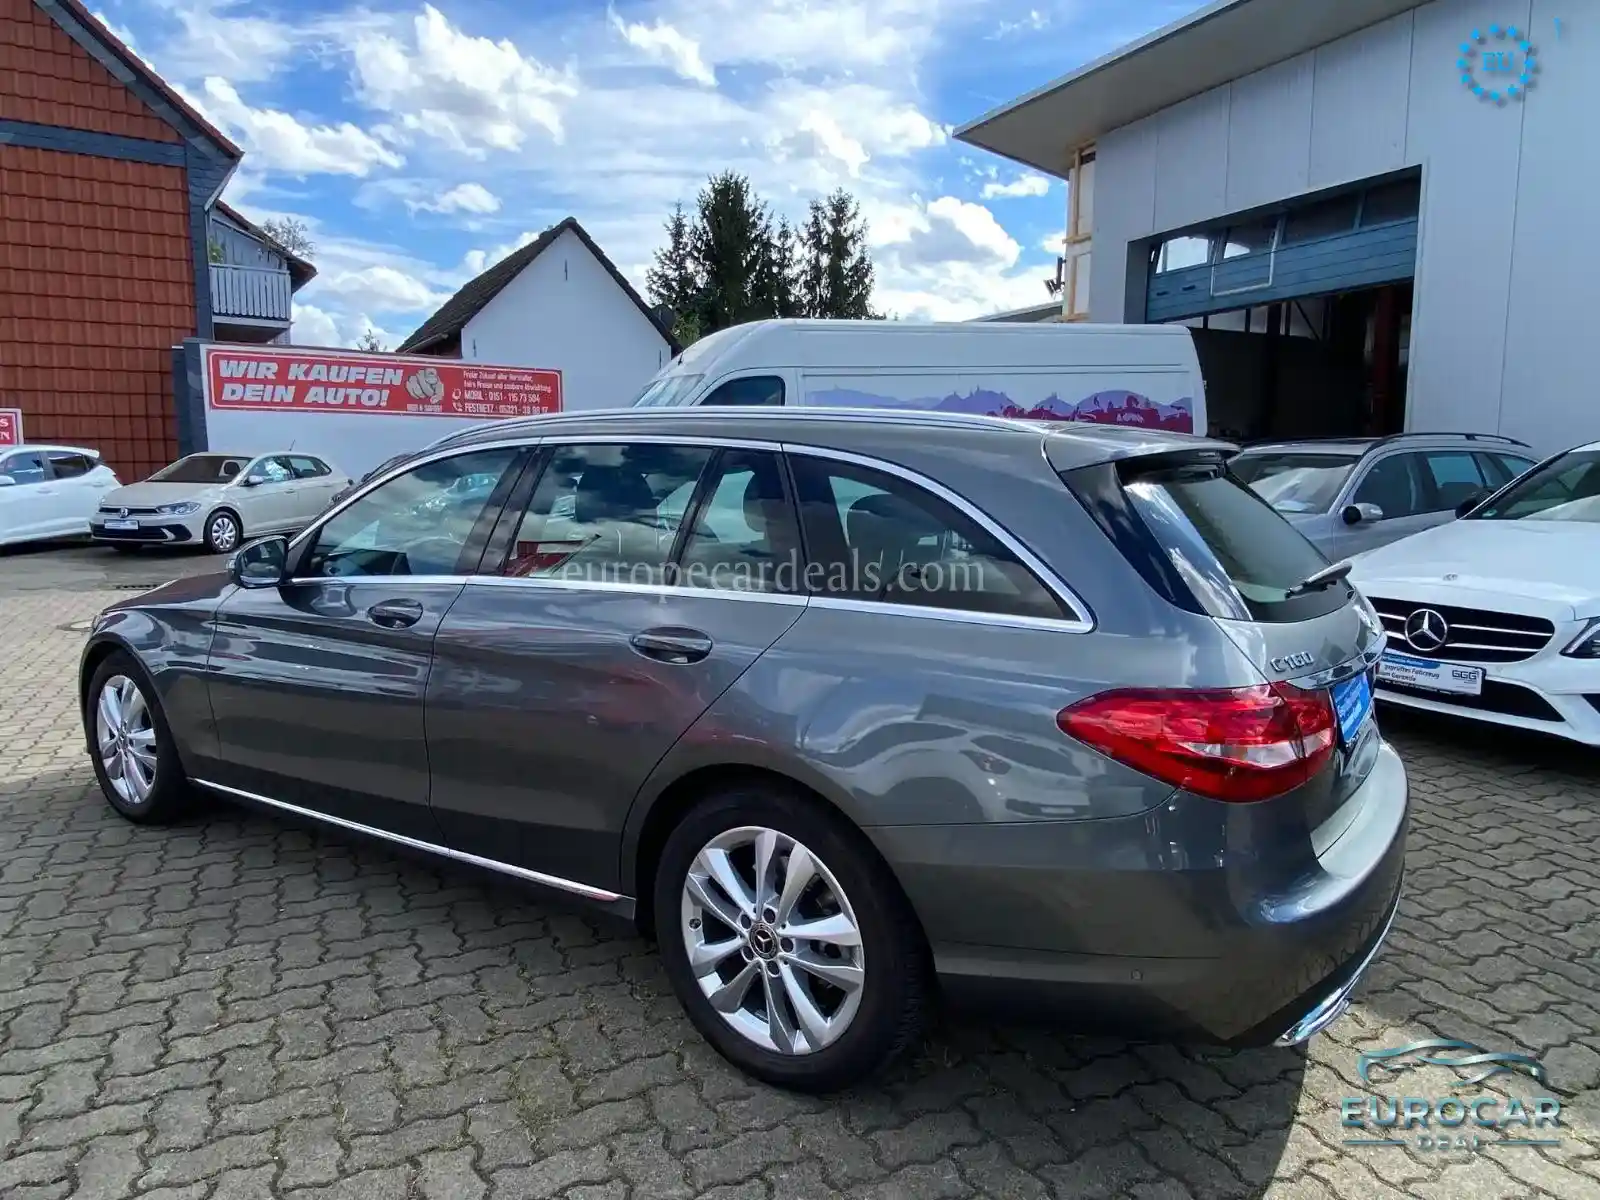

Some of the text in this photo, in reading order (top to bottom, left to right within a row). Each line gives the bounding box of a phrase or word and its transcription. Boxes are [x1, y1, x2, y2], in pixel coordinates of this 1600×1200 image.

[218, 359, 404, 386] WIR KAUFEN
[222, 383, 390, 407] DEIN AUTO!
